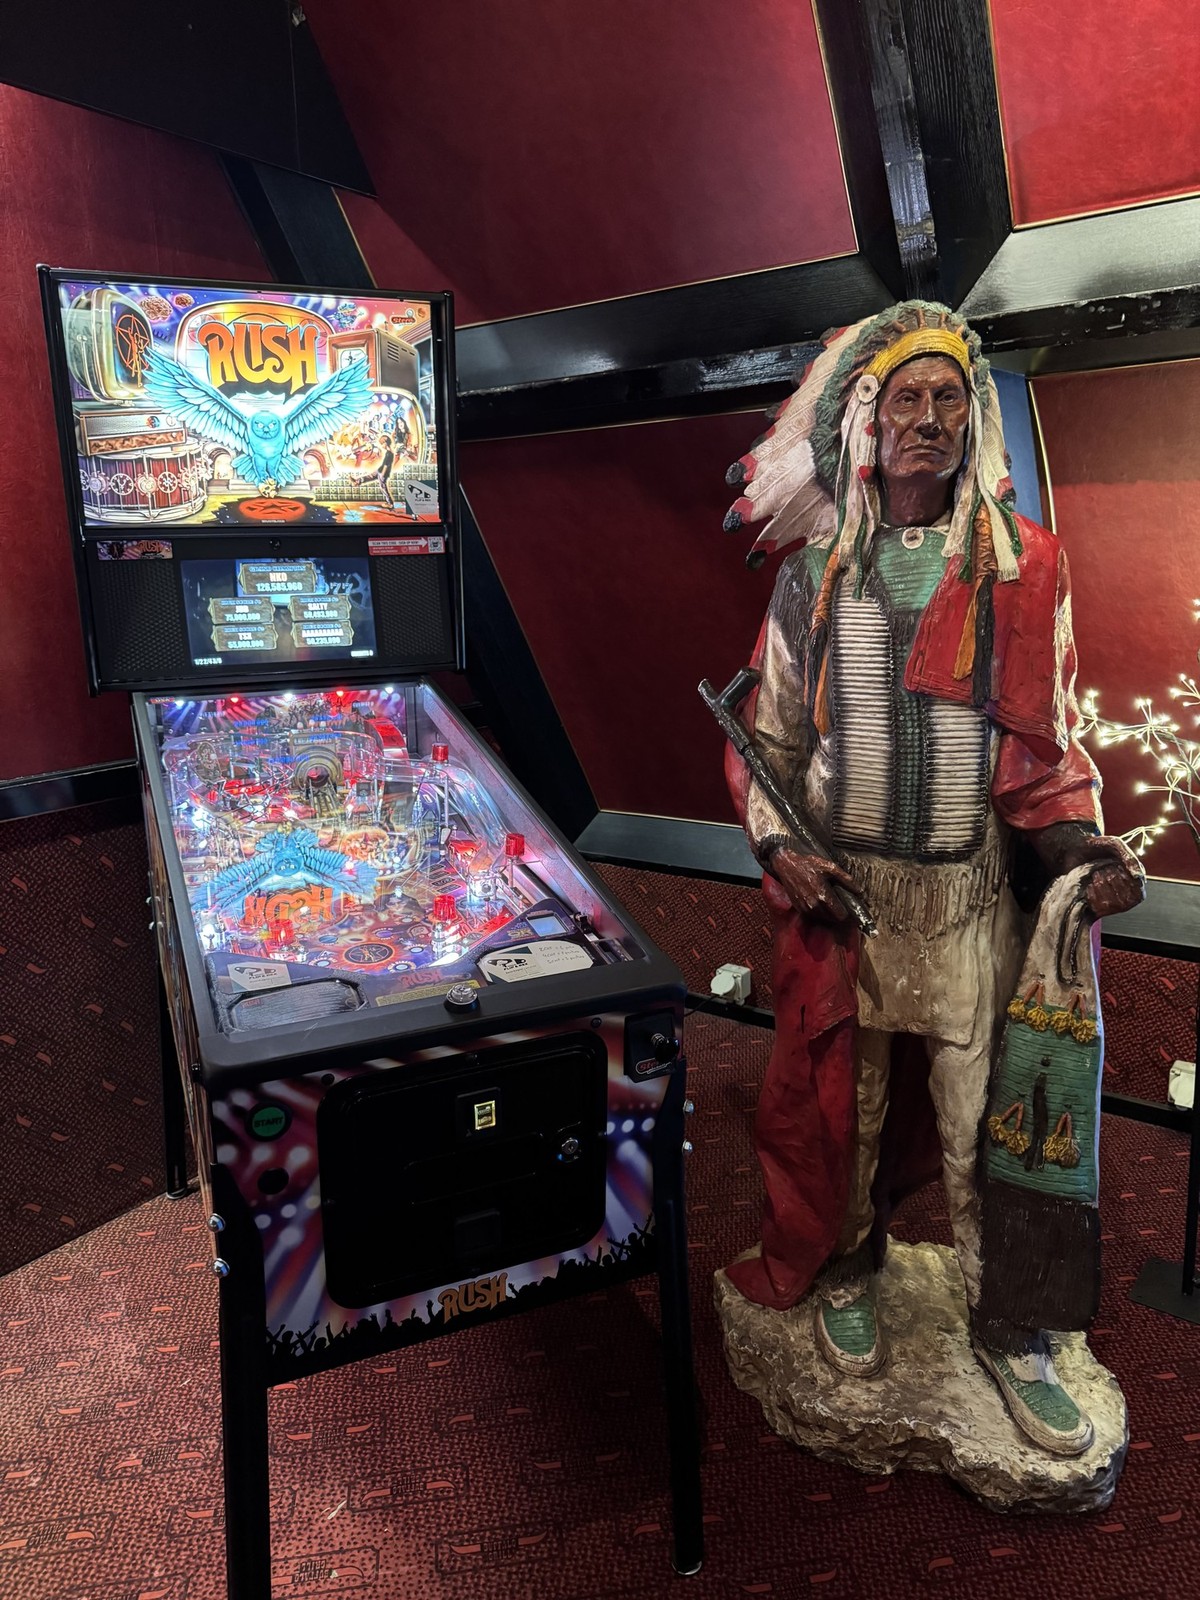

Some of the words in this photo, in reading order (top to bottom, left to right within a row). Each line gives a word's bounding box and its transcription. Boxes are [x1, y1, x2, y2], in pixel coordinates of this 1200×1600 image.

[198, 321, 319, 395] RUSH
[254, 1116, 284, 1128] START
[438, 1272, 508, 1324] RUSH
